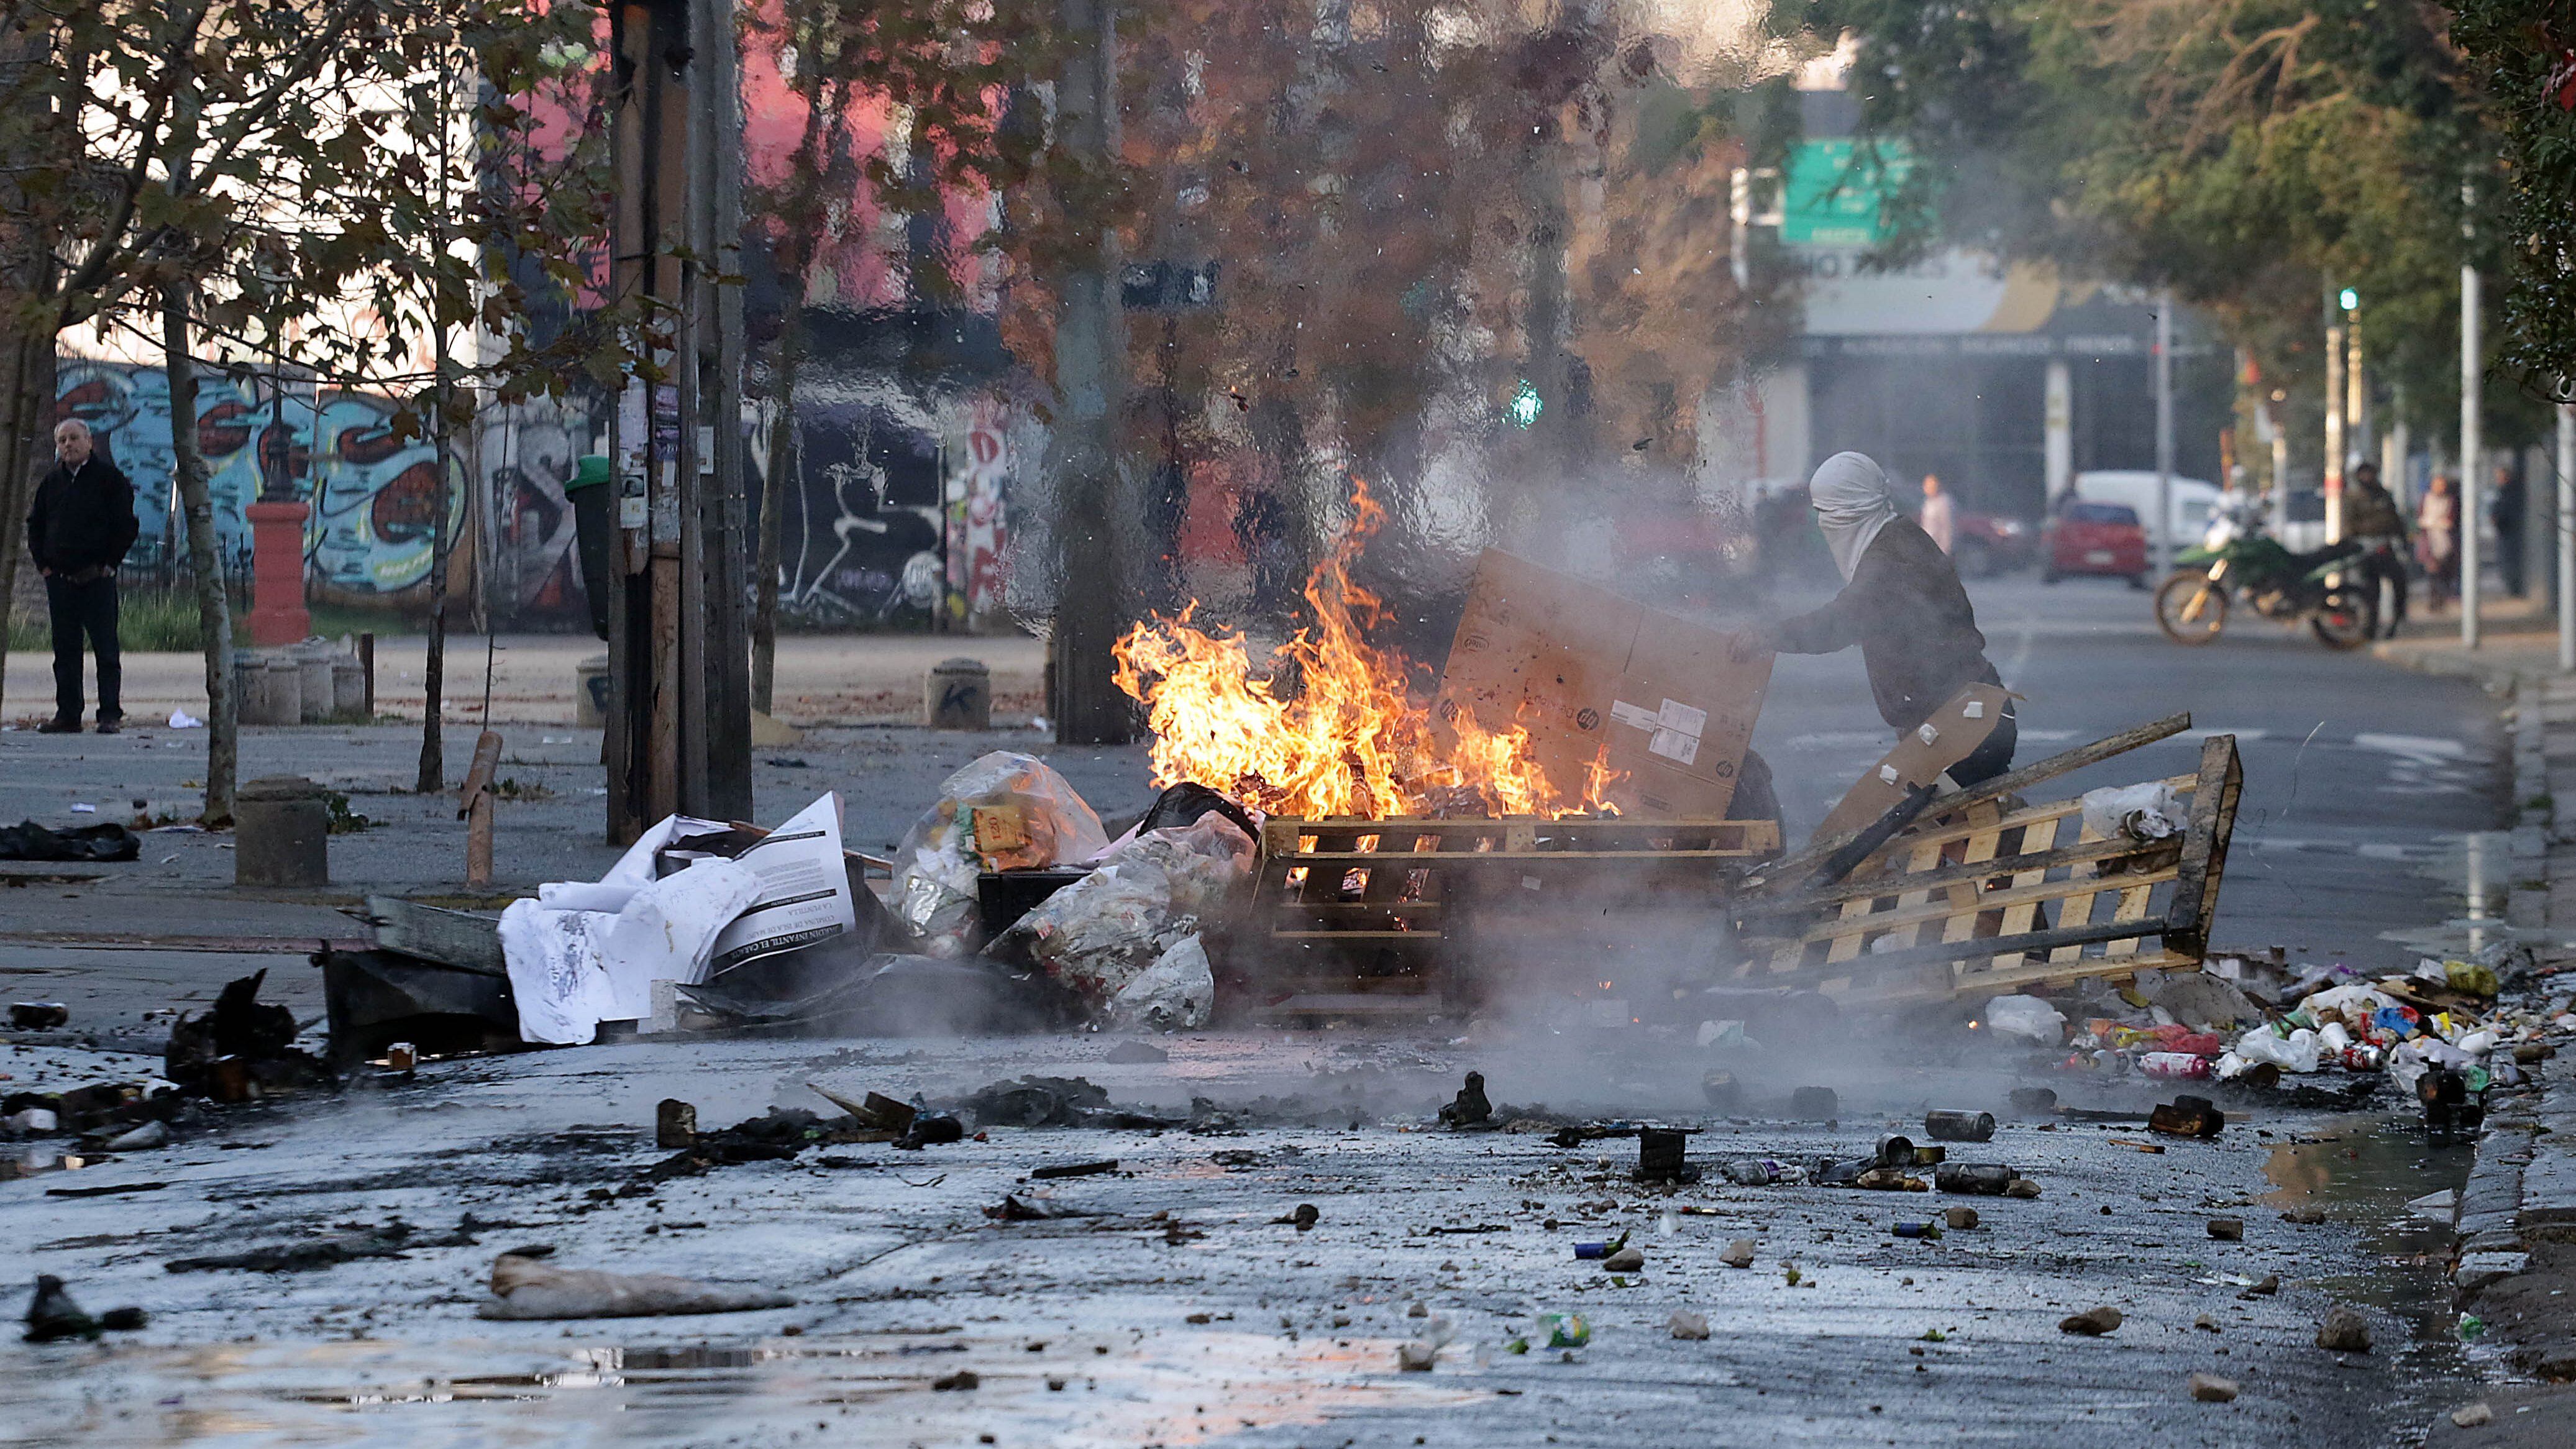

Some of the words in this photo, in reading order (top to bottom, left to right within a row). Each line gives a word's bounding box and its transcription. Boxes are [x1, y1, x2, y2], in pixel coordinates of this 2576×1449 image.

[1578, 708, 1599, 730] hp
[988, 816, 1002, 841] 120
[759, 940, 770, 949] EL
[770, 932, 808, 946] INFANTIL
